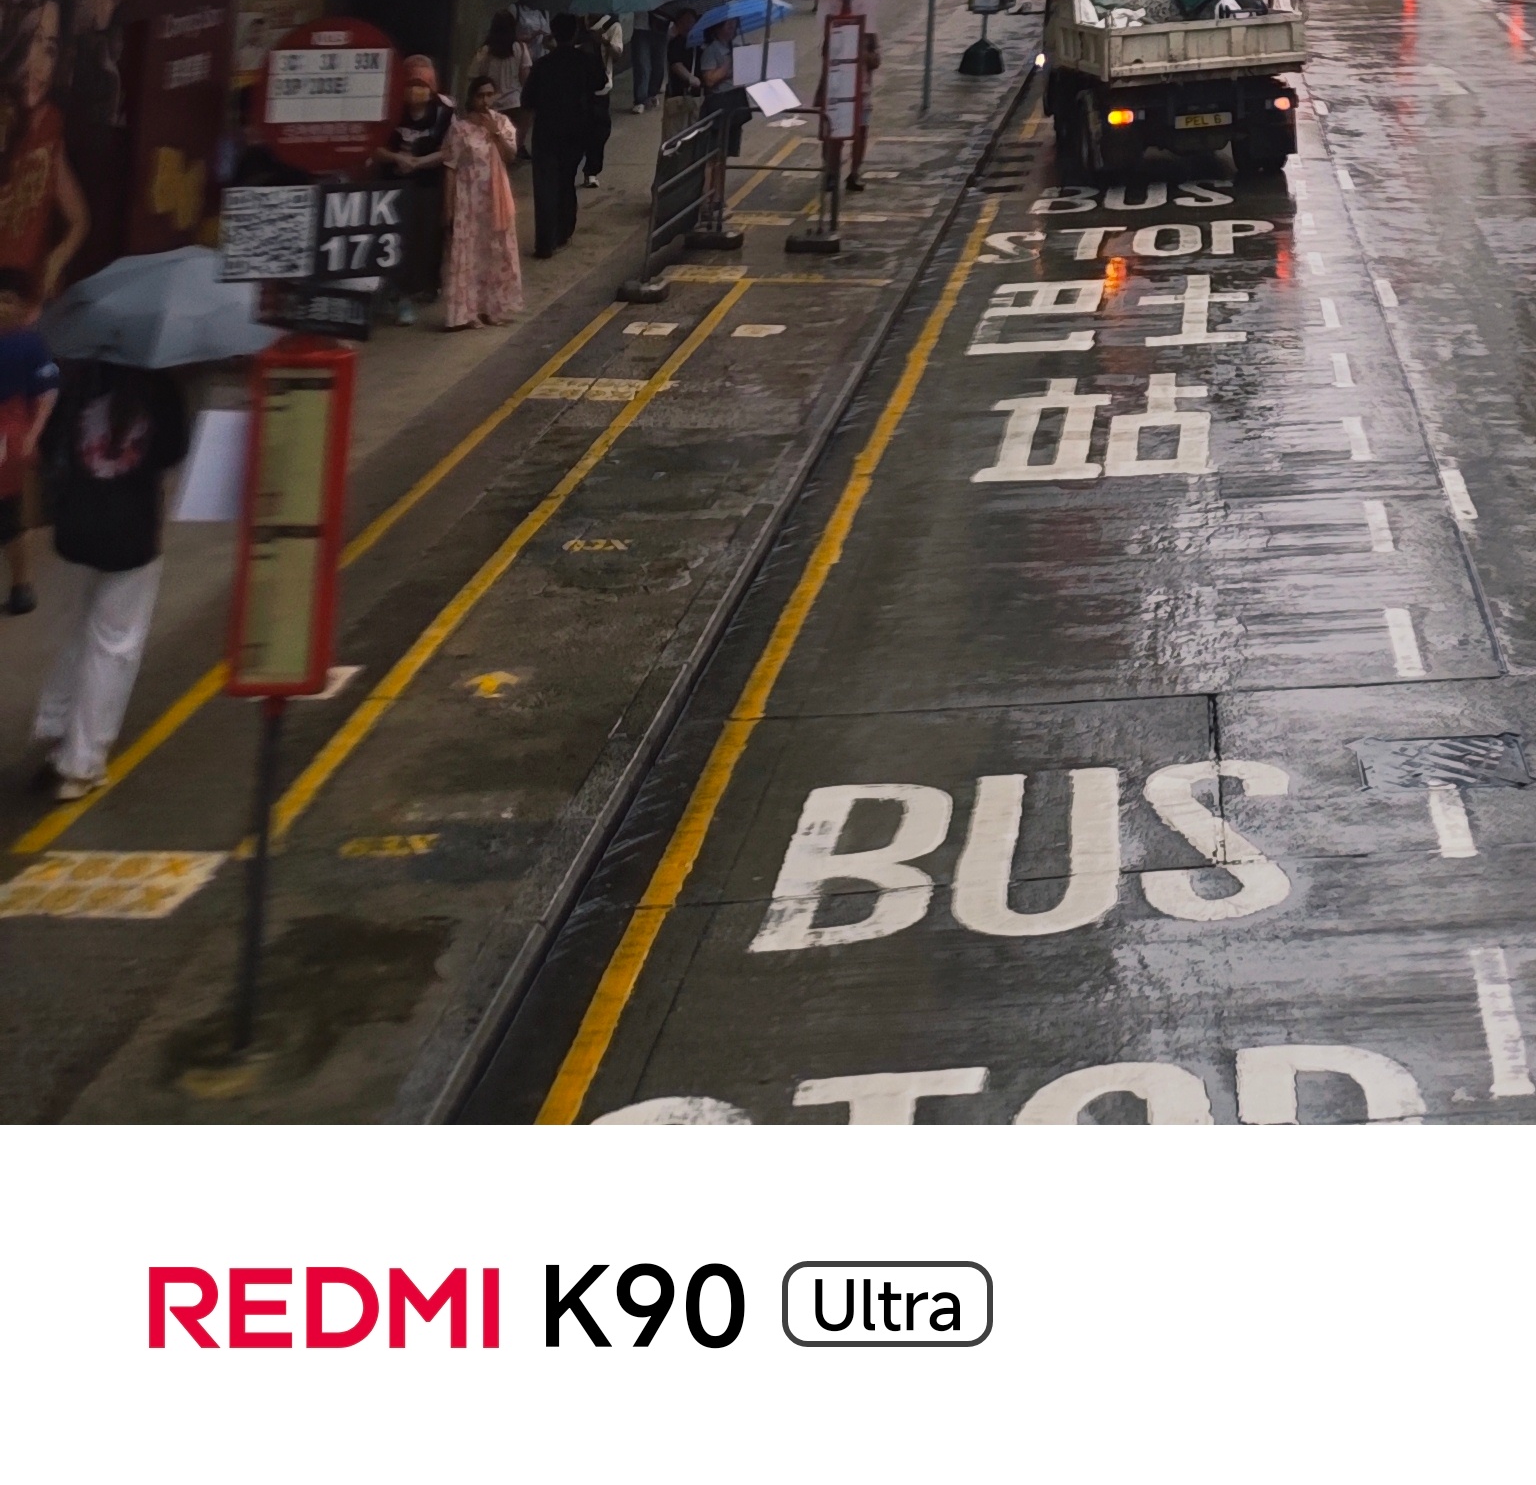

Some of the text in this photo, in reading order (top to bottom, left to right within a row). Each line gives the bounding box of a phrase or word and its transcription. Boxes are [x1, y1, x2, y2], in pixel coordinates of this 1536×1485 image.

[324, 188, 400, 228] MK
[1029, 180, 1235, 215] BUS
[320, 232, 400, 272] 173
[985, 219, 1275, 263] STOP
[966, 274, 1250, 356] 巴士
[970, 372, 1214, 483] 站
[748, 759, 1292, 953] BUS
